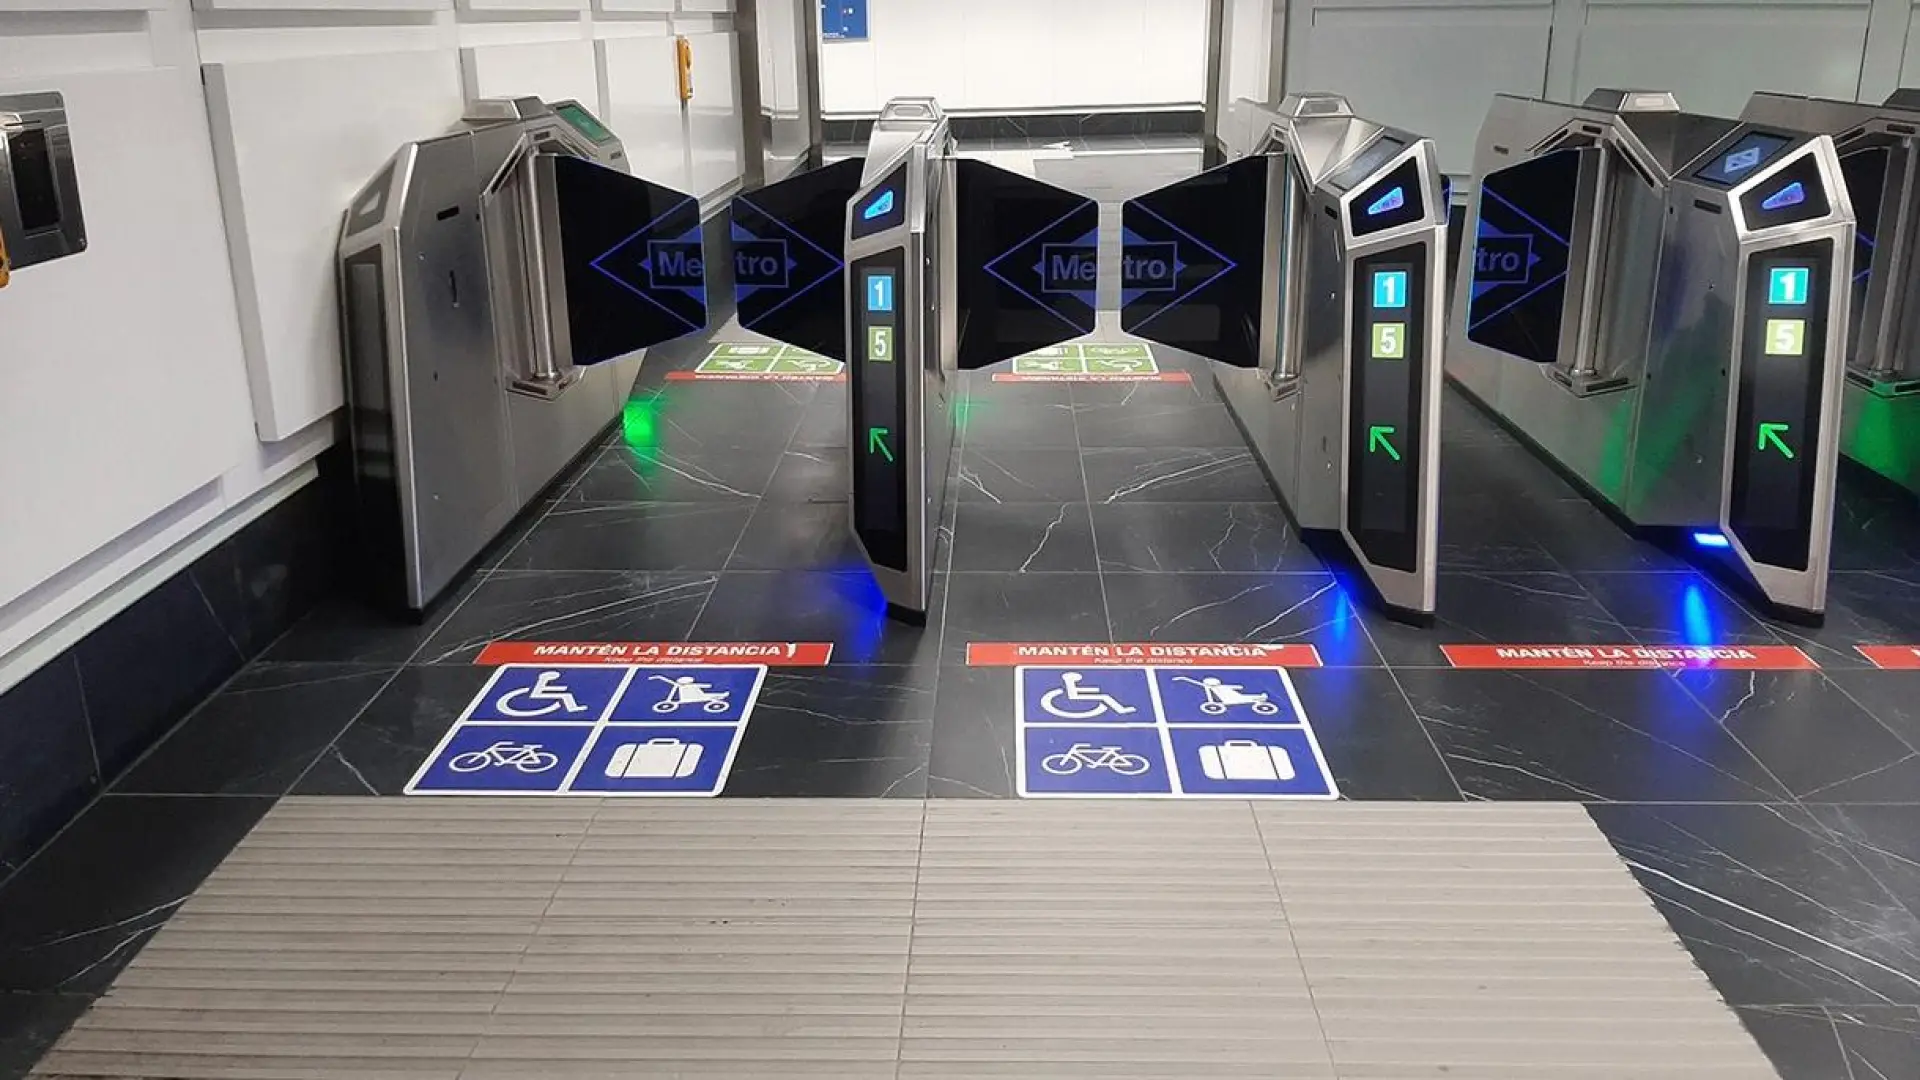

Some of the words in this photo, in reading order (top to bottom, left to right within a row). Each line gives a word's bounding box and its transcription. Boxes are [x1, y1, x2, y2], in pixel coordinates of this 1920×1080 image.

[873, 279, 884, 307] 1
[1382, 276, 1395, 303] 1
[1780, 271, 1797, 301] 1
[875, 330, 887, 357] 5
[1380, 327, 1397, 355] 5
[1774, 323, 1796, 351] 5
[533, 644, 627, 656] MANTÉN
[632, 646, 659, 656] LA
[667, 646, 781, 656] DISTANCIA
[1018, 644, 1109, 656] MANTÉN
[1116, 646, 1144, 656] LA
[1150, 646, 1268, 656] DISTANCIA
[1495, 646, 1595, 659] MANTÉN
[1597, 648, 1630, 659] LA
[1632, 649, 1757, 659] DISTANCIA
